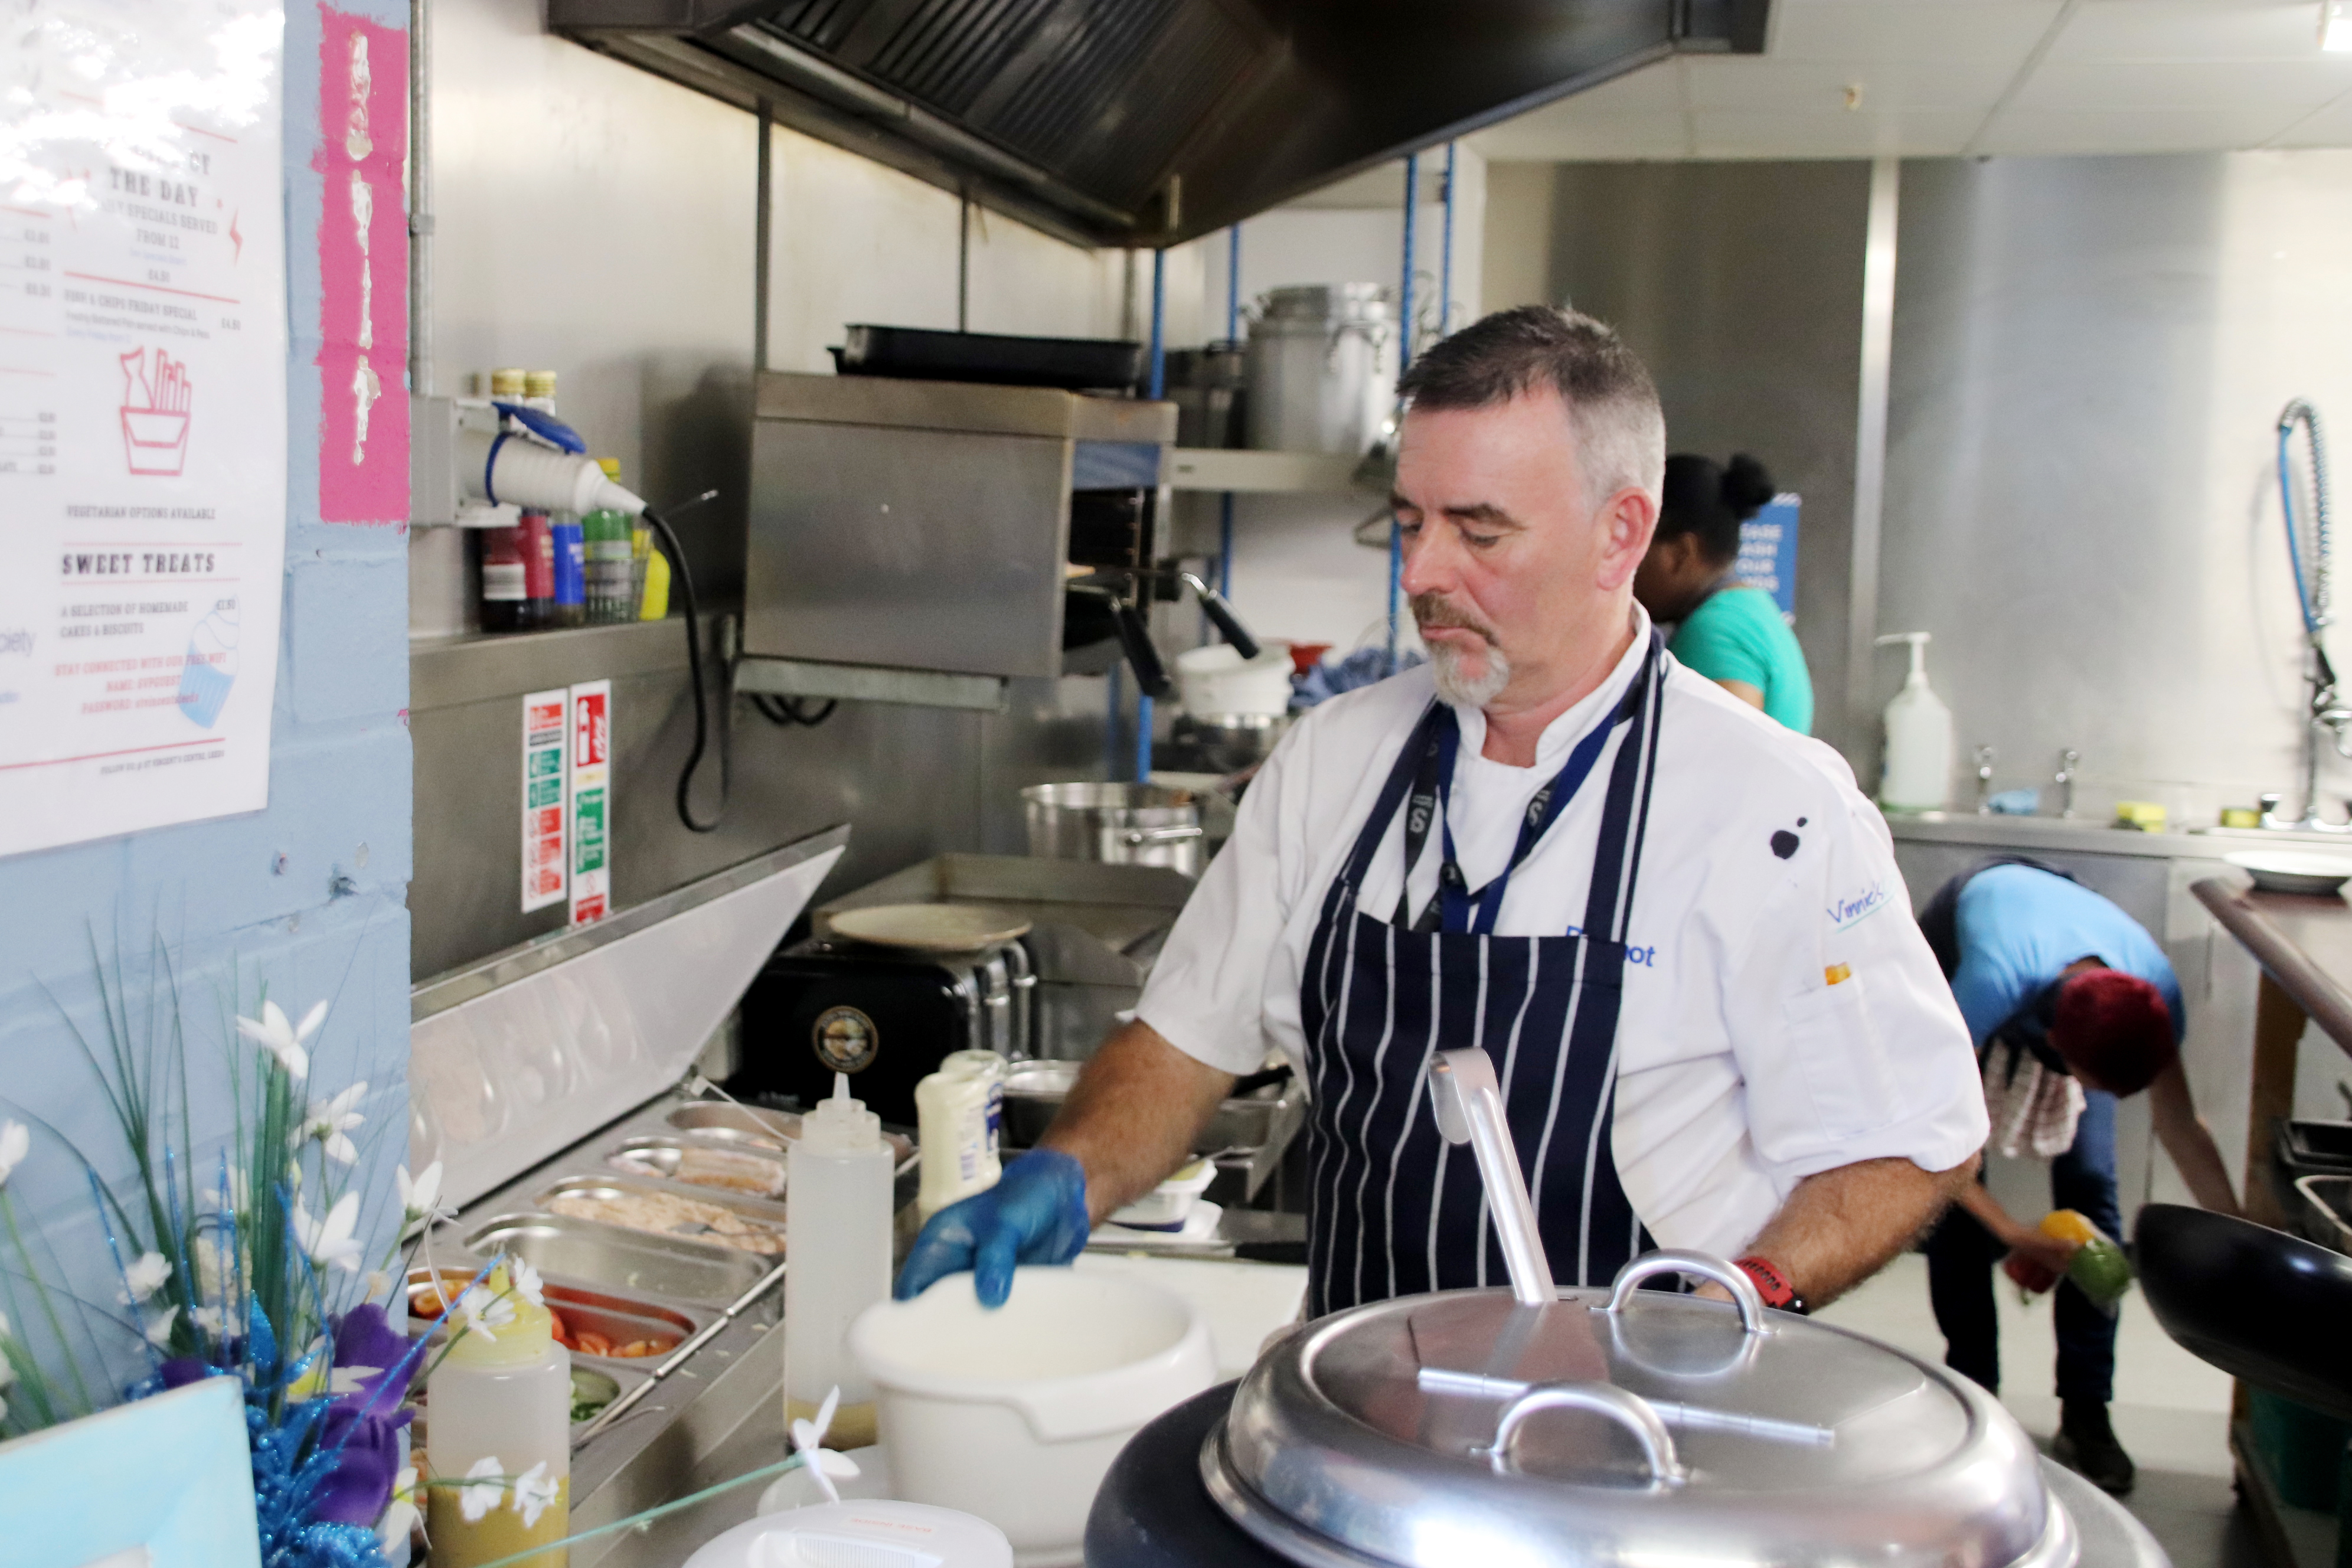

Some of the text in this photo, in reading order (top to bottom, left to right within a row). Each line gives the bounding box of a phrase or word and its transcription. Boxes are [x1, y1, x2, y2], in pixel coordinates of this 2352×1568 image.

[110, 167, 198, 207] THE DAY
[128, 203, 177, 226] SPECIALS
[180, 214, 218, 234] SERVED
[137, 228, 166, 247] FROM
[98, 295, 125, 309] CHIPS
[128, 299, 160, 314] FRIDAY
[163, 305, 197, 320] SPECIAL
[67, 505, 216, 520] VEGETARIAN OPTIONS AVAILABLE
[1739, 523, 1783, 540] EASE
[1738, 542, 1778, 558] ASH
[63, 553, 215, 574] SWEET TREATS
[1734, 558, 1775, 574] OUR
[61, 601, 188, 617] A SELECTION OF HOMEMADE
[60, 625, 91, 637] CAKES
[103, 622, 144, 635] BISCUITS
[55, 652, 227, 676] STAY CONNECTED WITH OUR FREE WIFI
